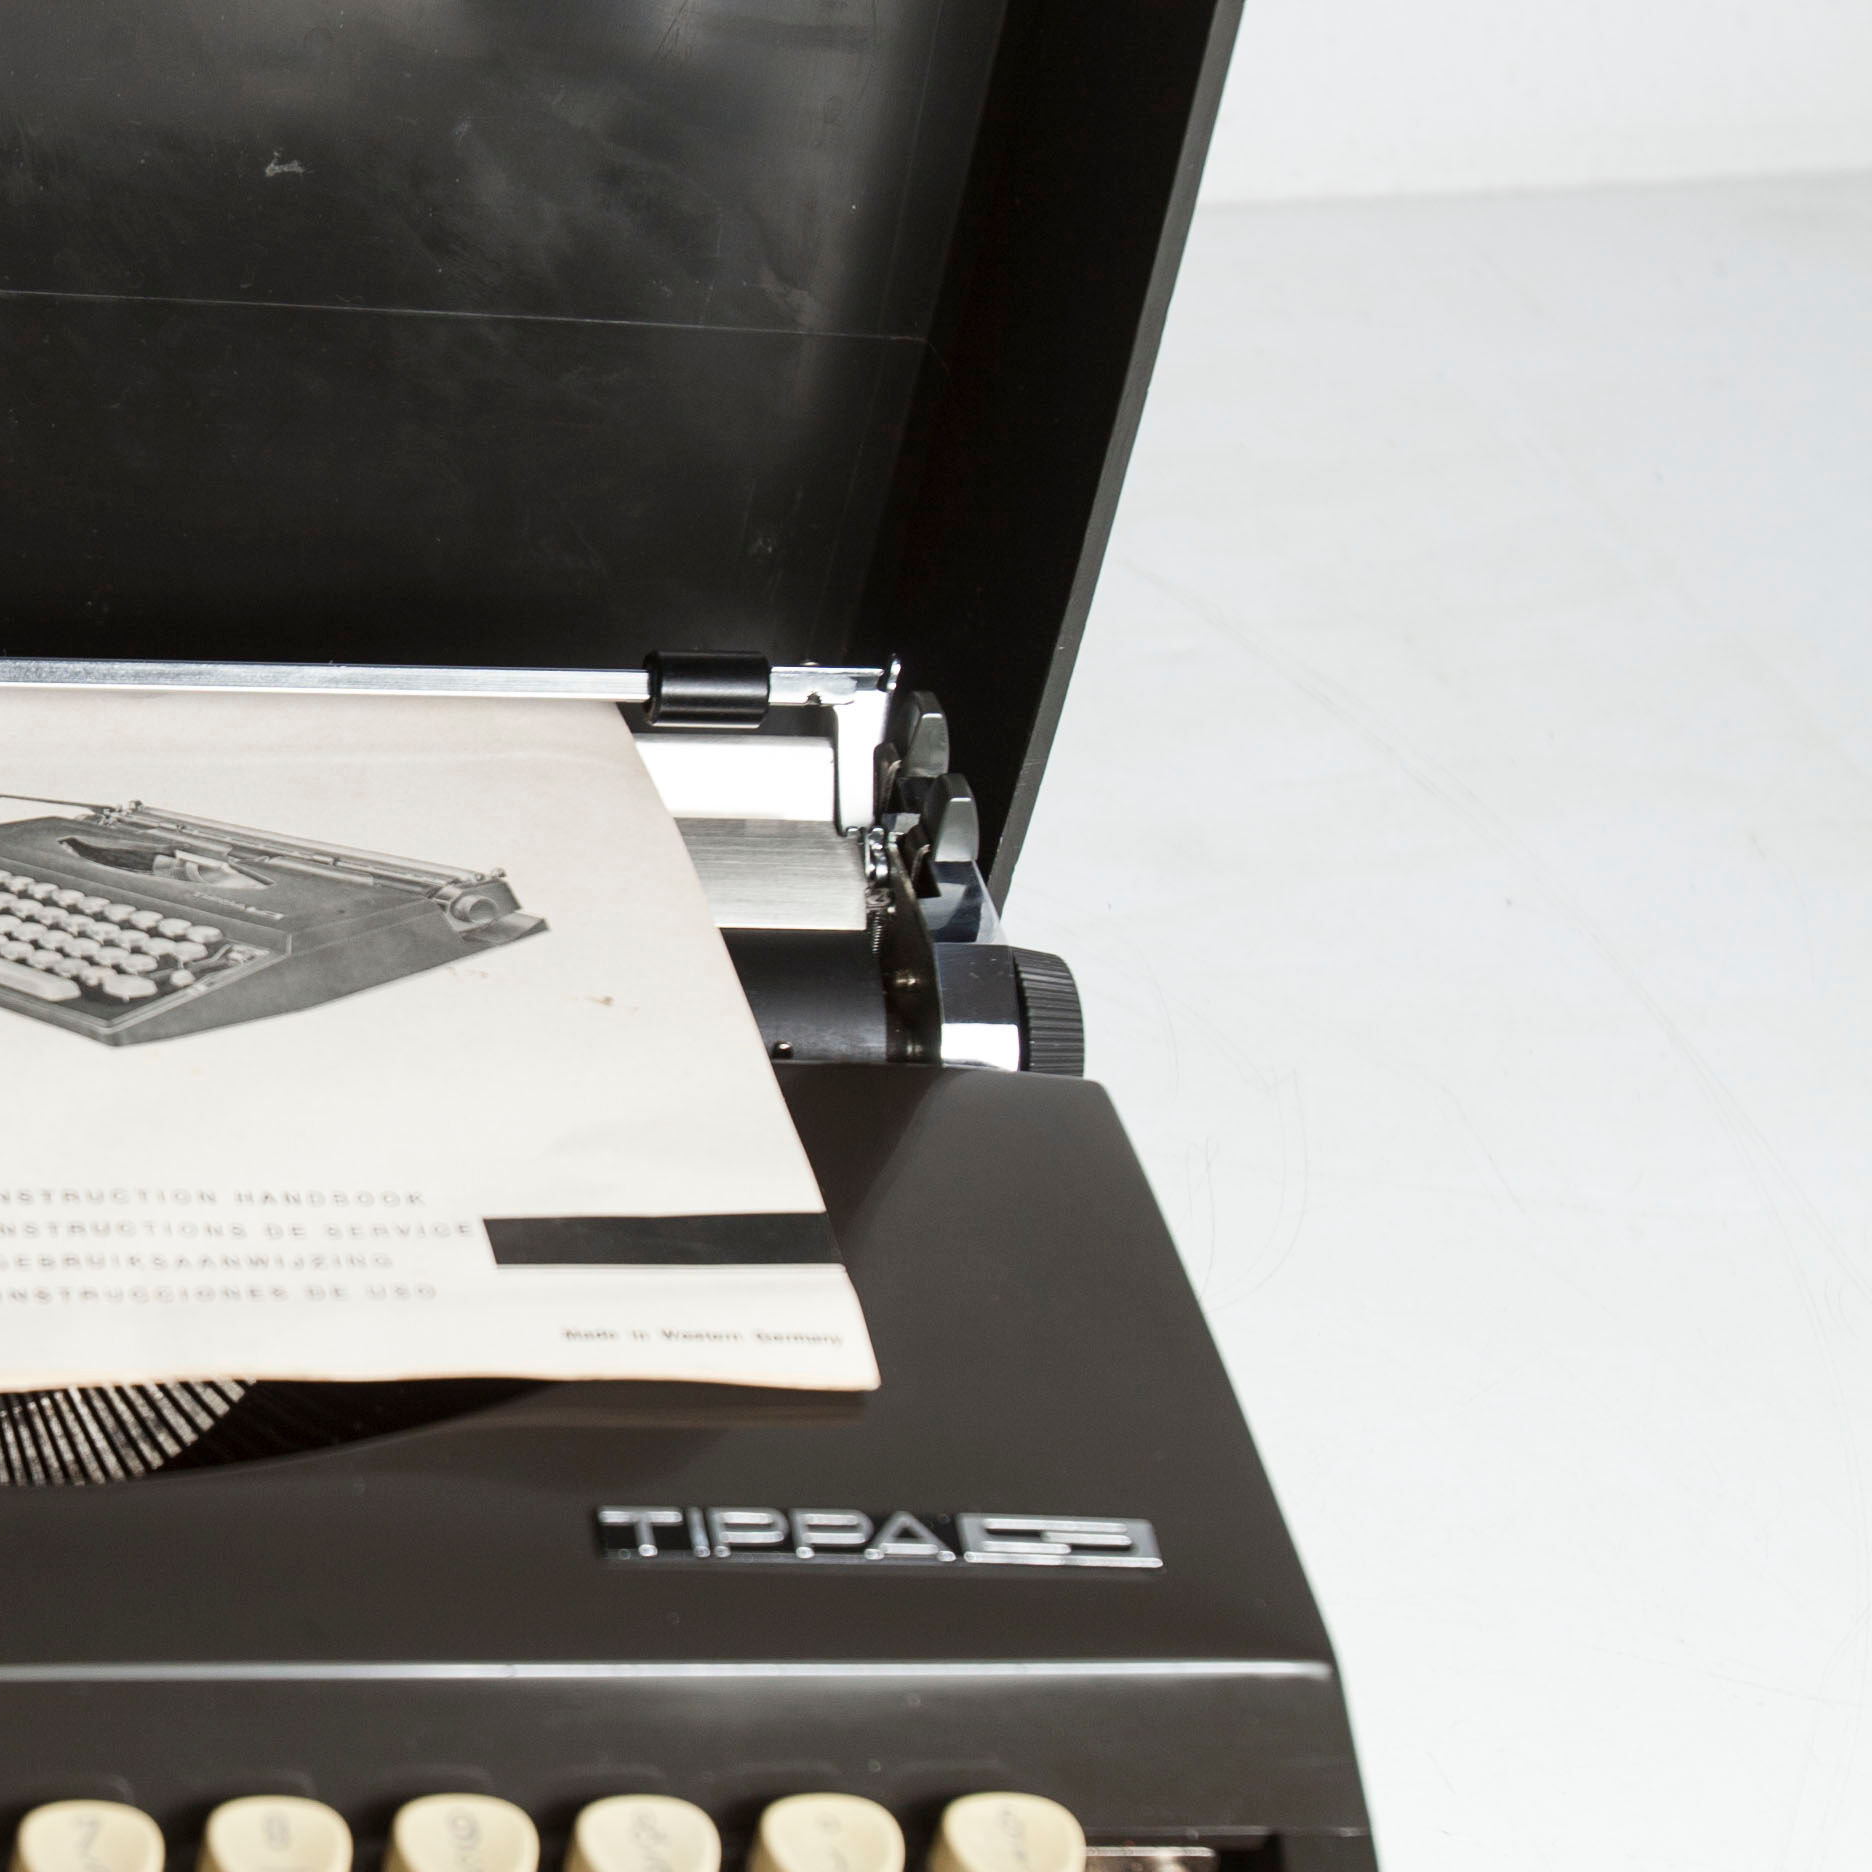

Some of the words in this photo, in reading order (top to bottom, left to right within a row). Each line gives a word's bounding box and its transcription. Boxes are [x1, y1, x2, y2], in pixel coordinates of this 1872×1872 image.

[232, 1189, 426, 1209] HANDBOOK
[263, 1221, 307, 1241] DE
[323, 1221, 474, 1241] SERVICE
[303, 1283, 352, 1303] DE
[364, 1282, 437, 1302] USO
[564, 1326, 616, 1341] Made
[659, 1327, 740, 1344] Western
[754, 1329, 841, 1349] Germany
[596, 1505, 957, 1562] TIPPA
